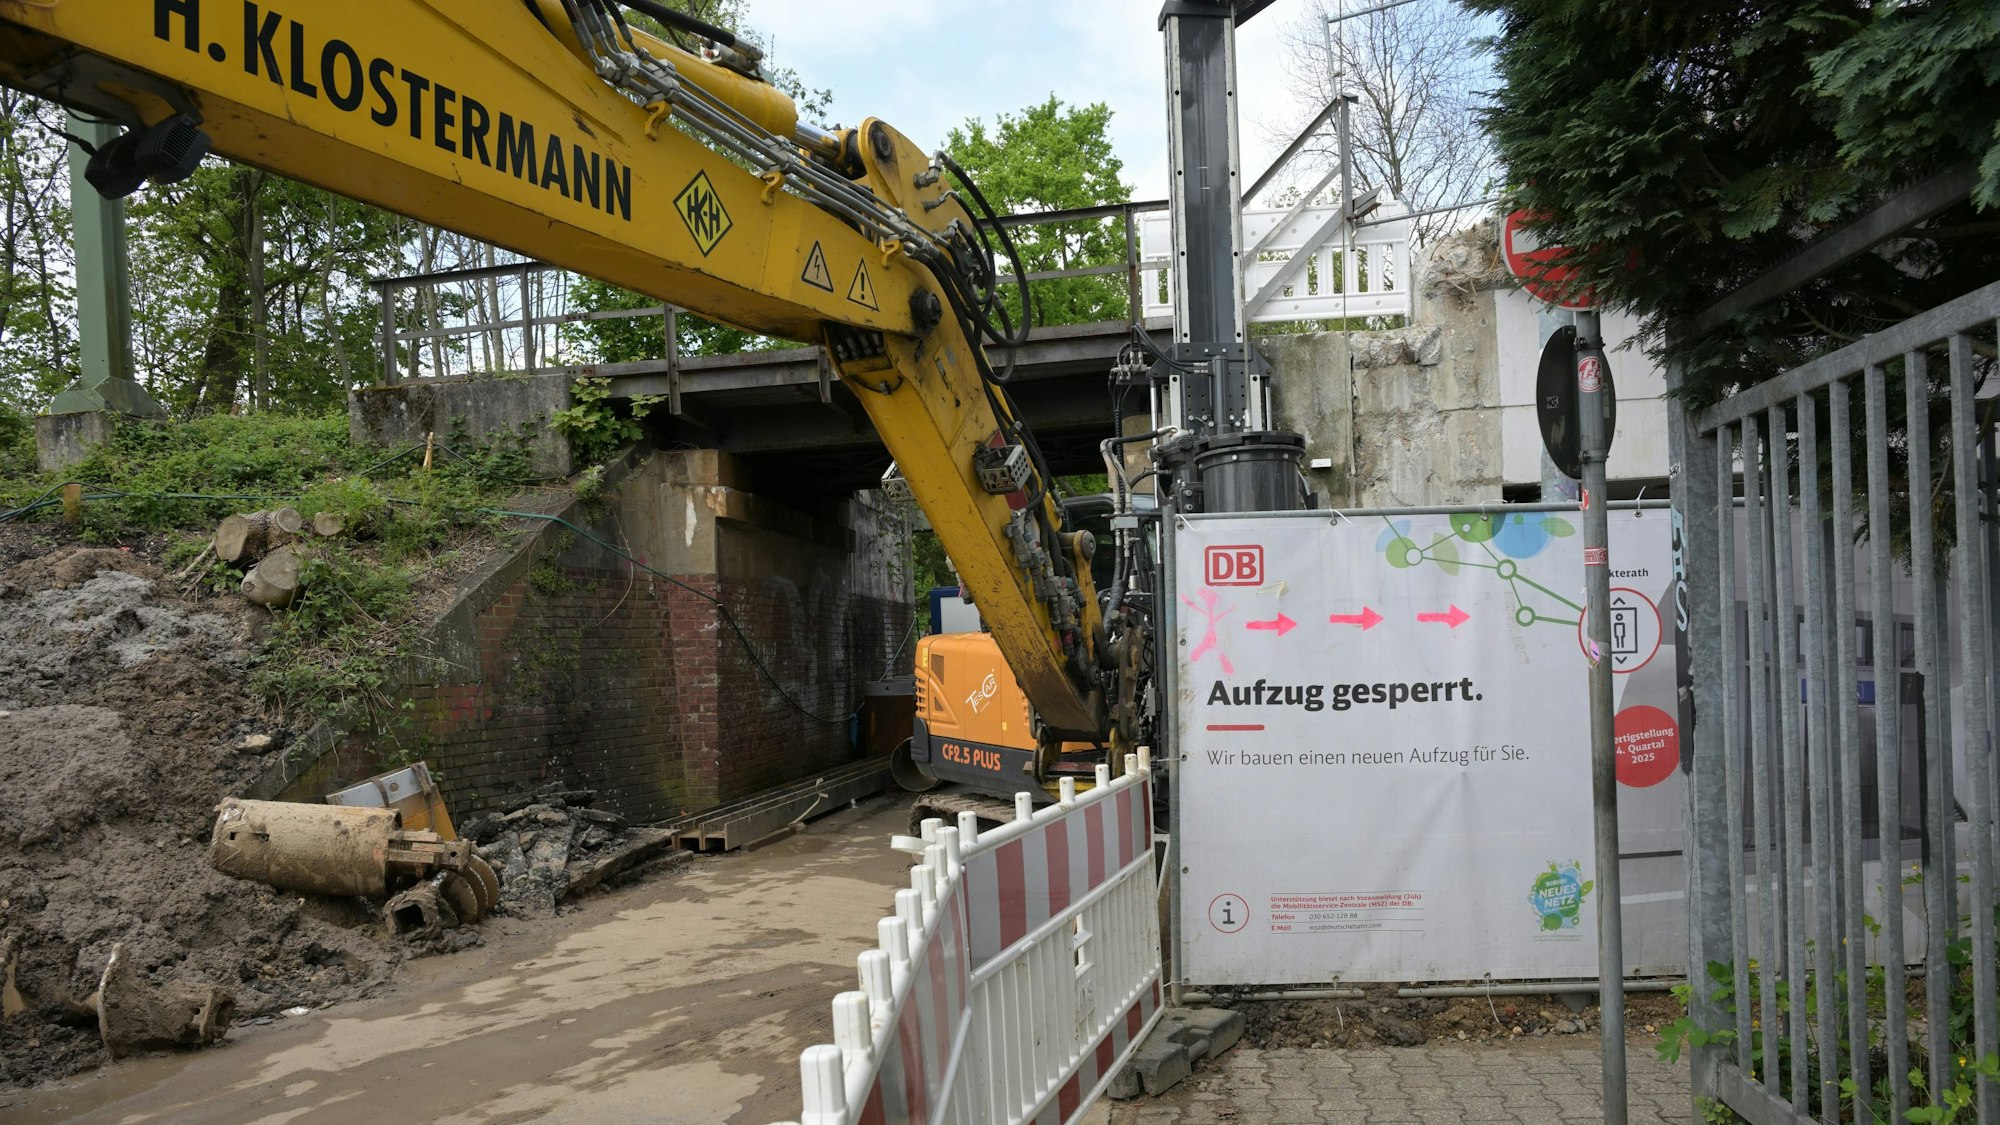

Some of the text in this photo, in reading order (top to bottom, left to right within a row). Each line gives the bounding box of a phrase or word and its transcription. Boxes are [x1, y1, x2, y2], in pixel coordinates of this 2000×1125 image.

[154, 0, 632, 222] H. KLOSTERMANN
[1213, 552, 1257, 579] DB
[1609, 568, 1649, 578] kterath
[1207, 677, 1483, 711] Aufzug gesperrt.
[1614, 728, 1674, 744] ertigstellung
[1616, 739, 1665, 755] 4. Quartal
[942, 744, 1001, 771] CF2.5 PLUS
[1206, 744, 1530, 767] Wir bauen einen neuen Aufzug für Sie.
[1632, 753, 1655, 764] 2025
[1356, 893, 1402, 901] Voranmeldung
[1403, 893, 1422, 901] (24h)
[1539, 883, 1577, 899] NEUES
[1544, 894, 1575, 909] NETZ
